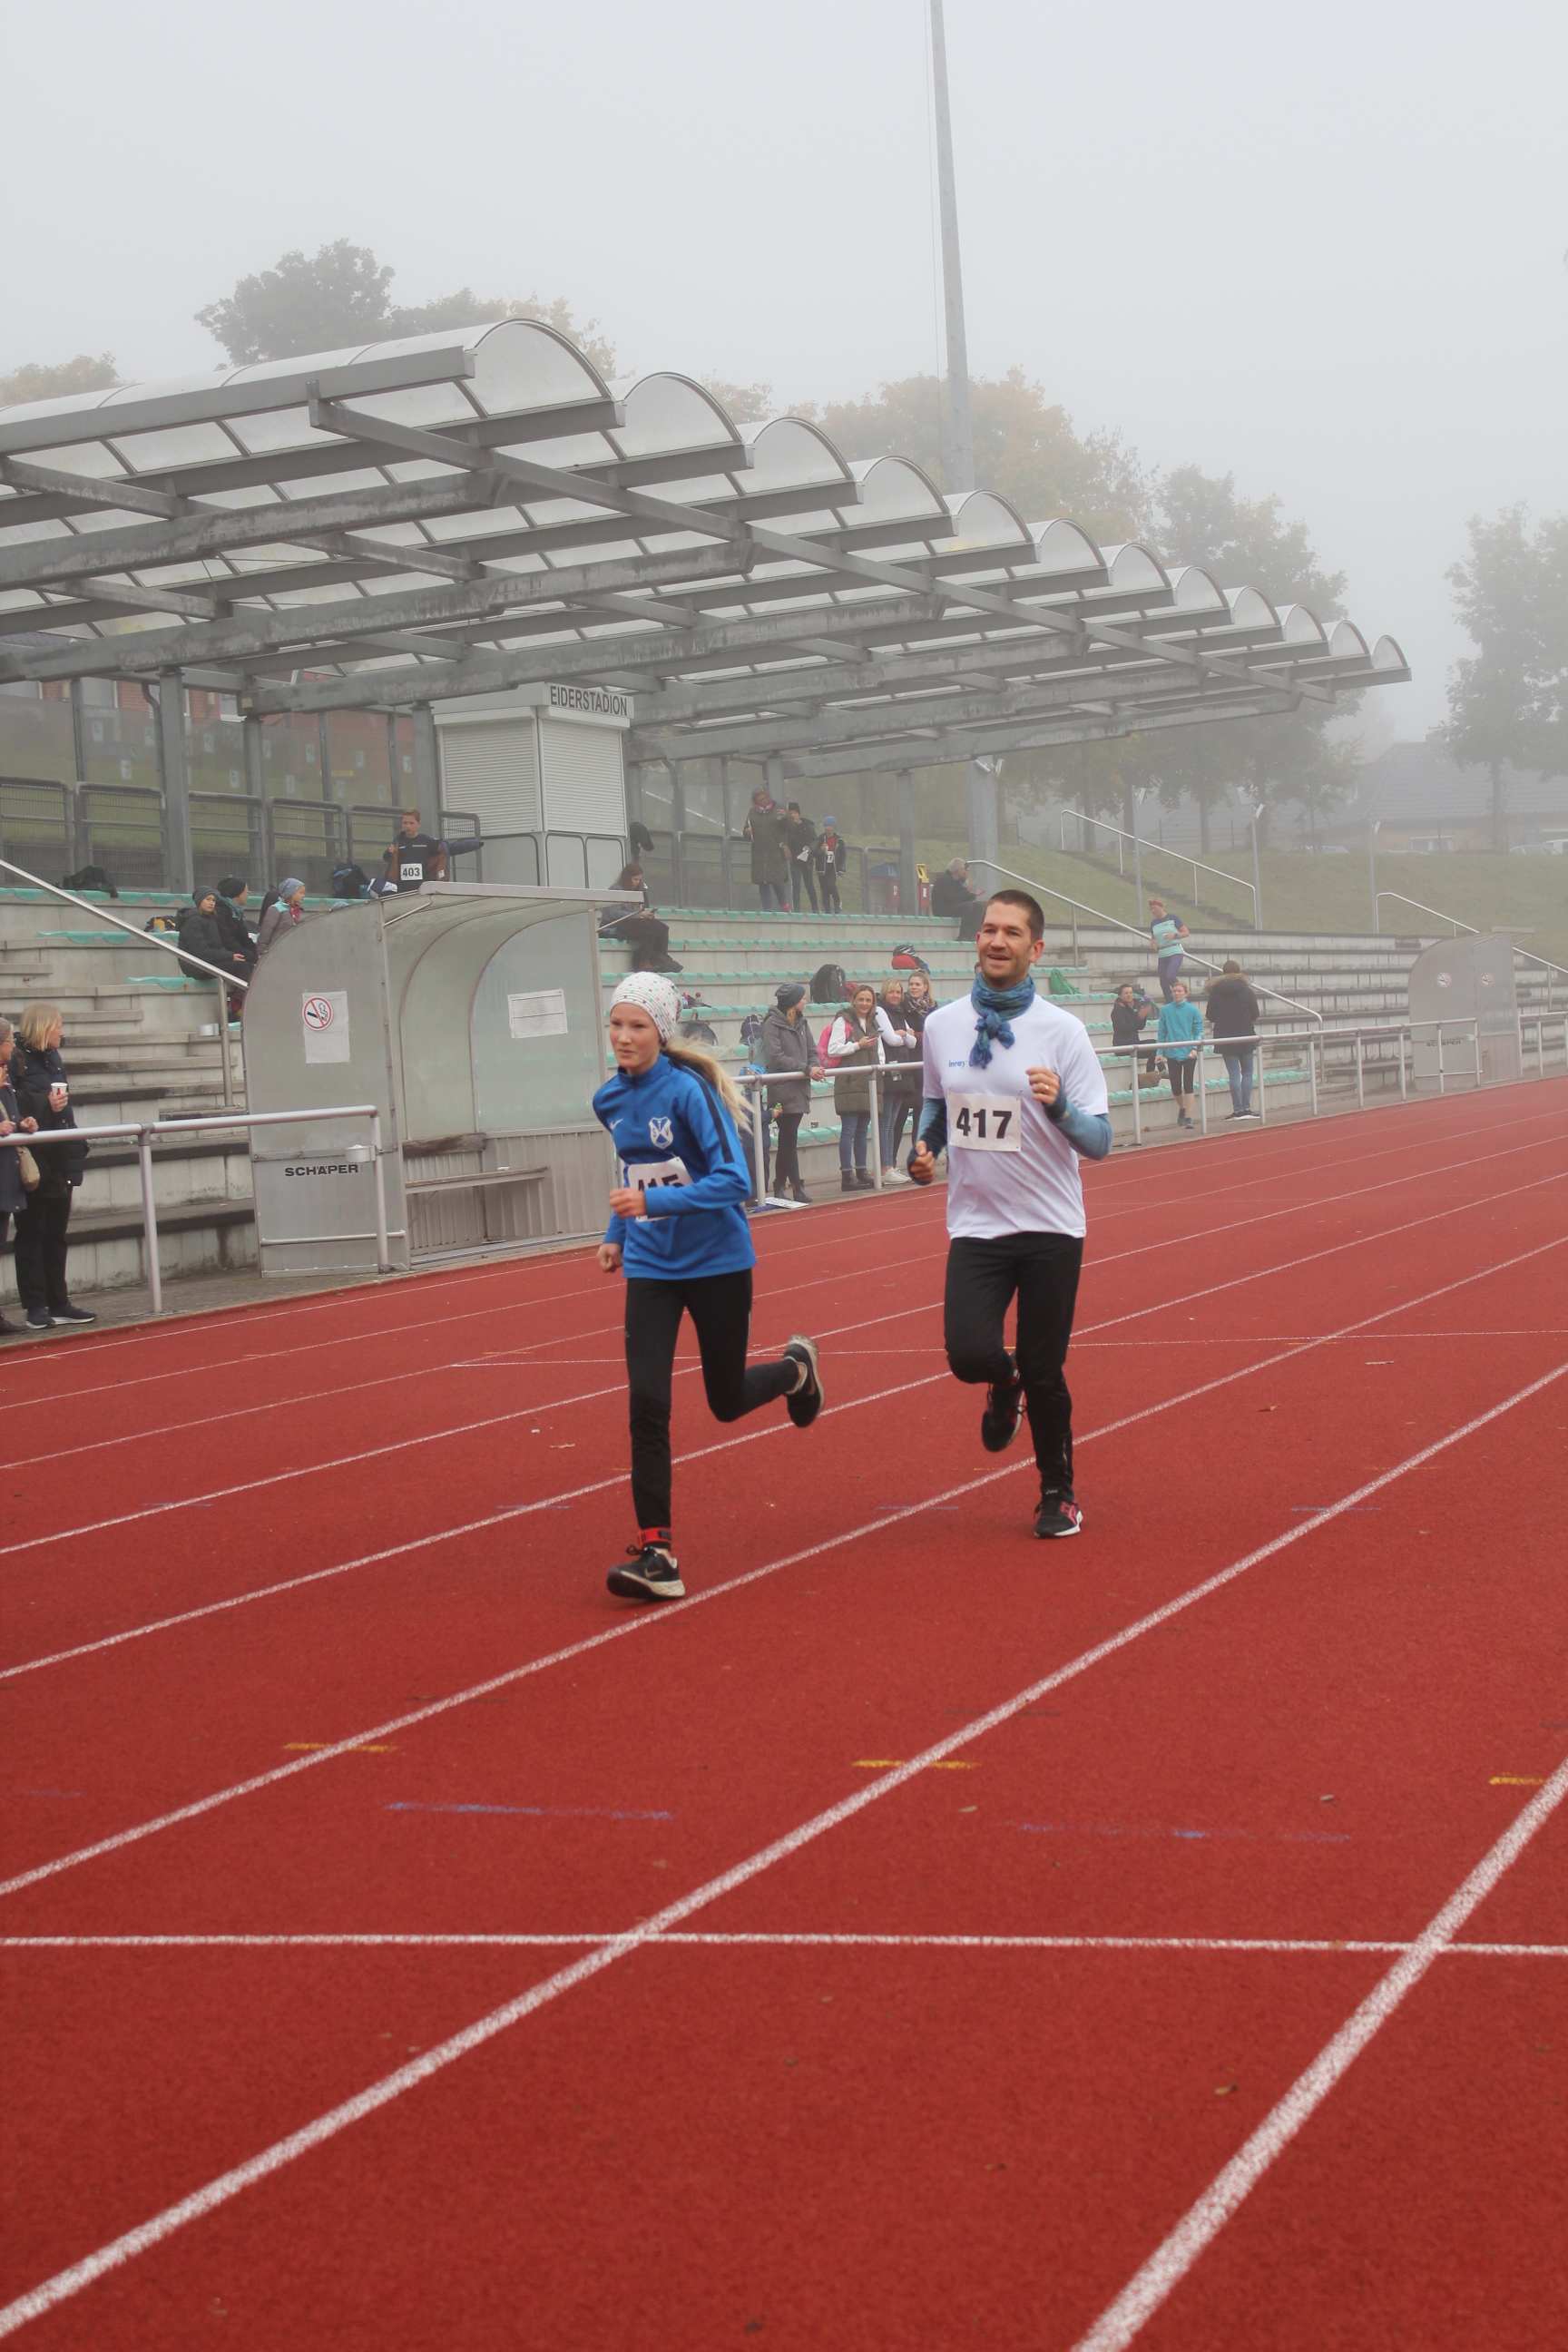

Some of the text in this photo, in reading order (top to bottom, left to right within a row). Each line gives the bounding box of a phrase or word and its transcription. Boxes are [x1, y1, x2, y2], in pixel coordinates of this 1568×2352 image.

[550, 685, 628, 716] EIDERSTADION
[402, 867, 420, 877] 403
[956, 1107, 1013, 1140] 417
[284, 1163, 359, 1177] SCHÄPER
